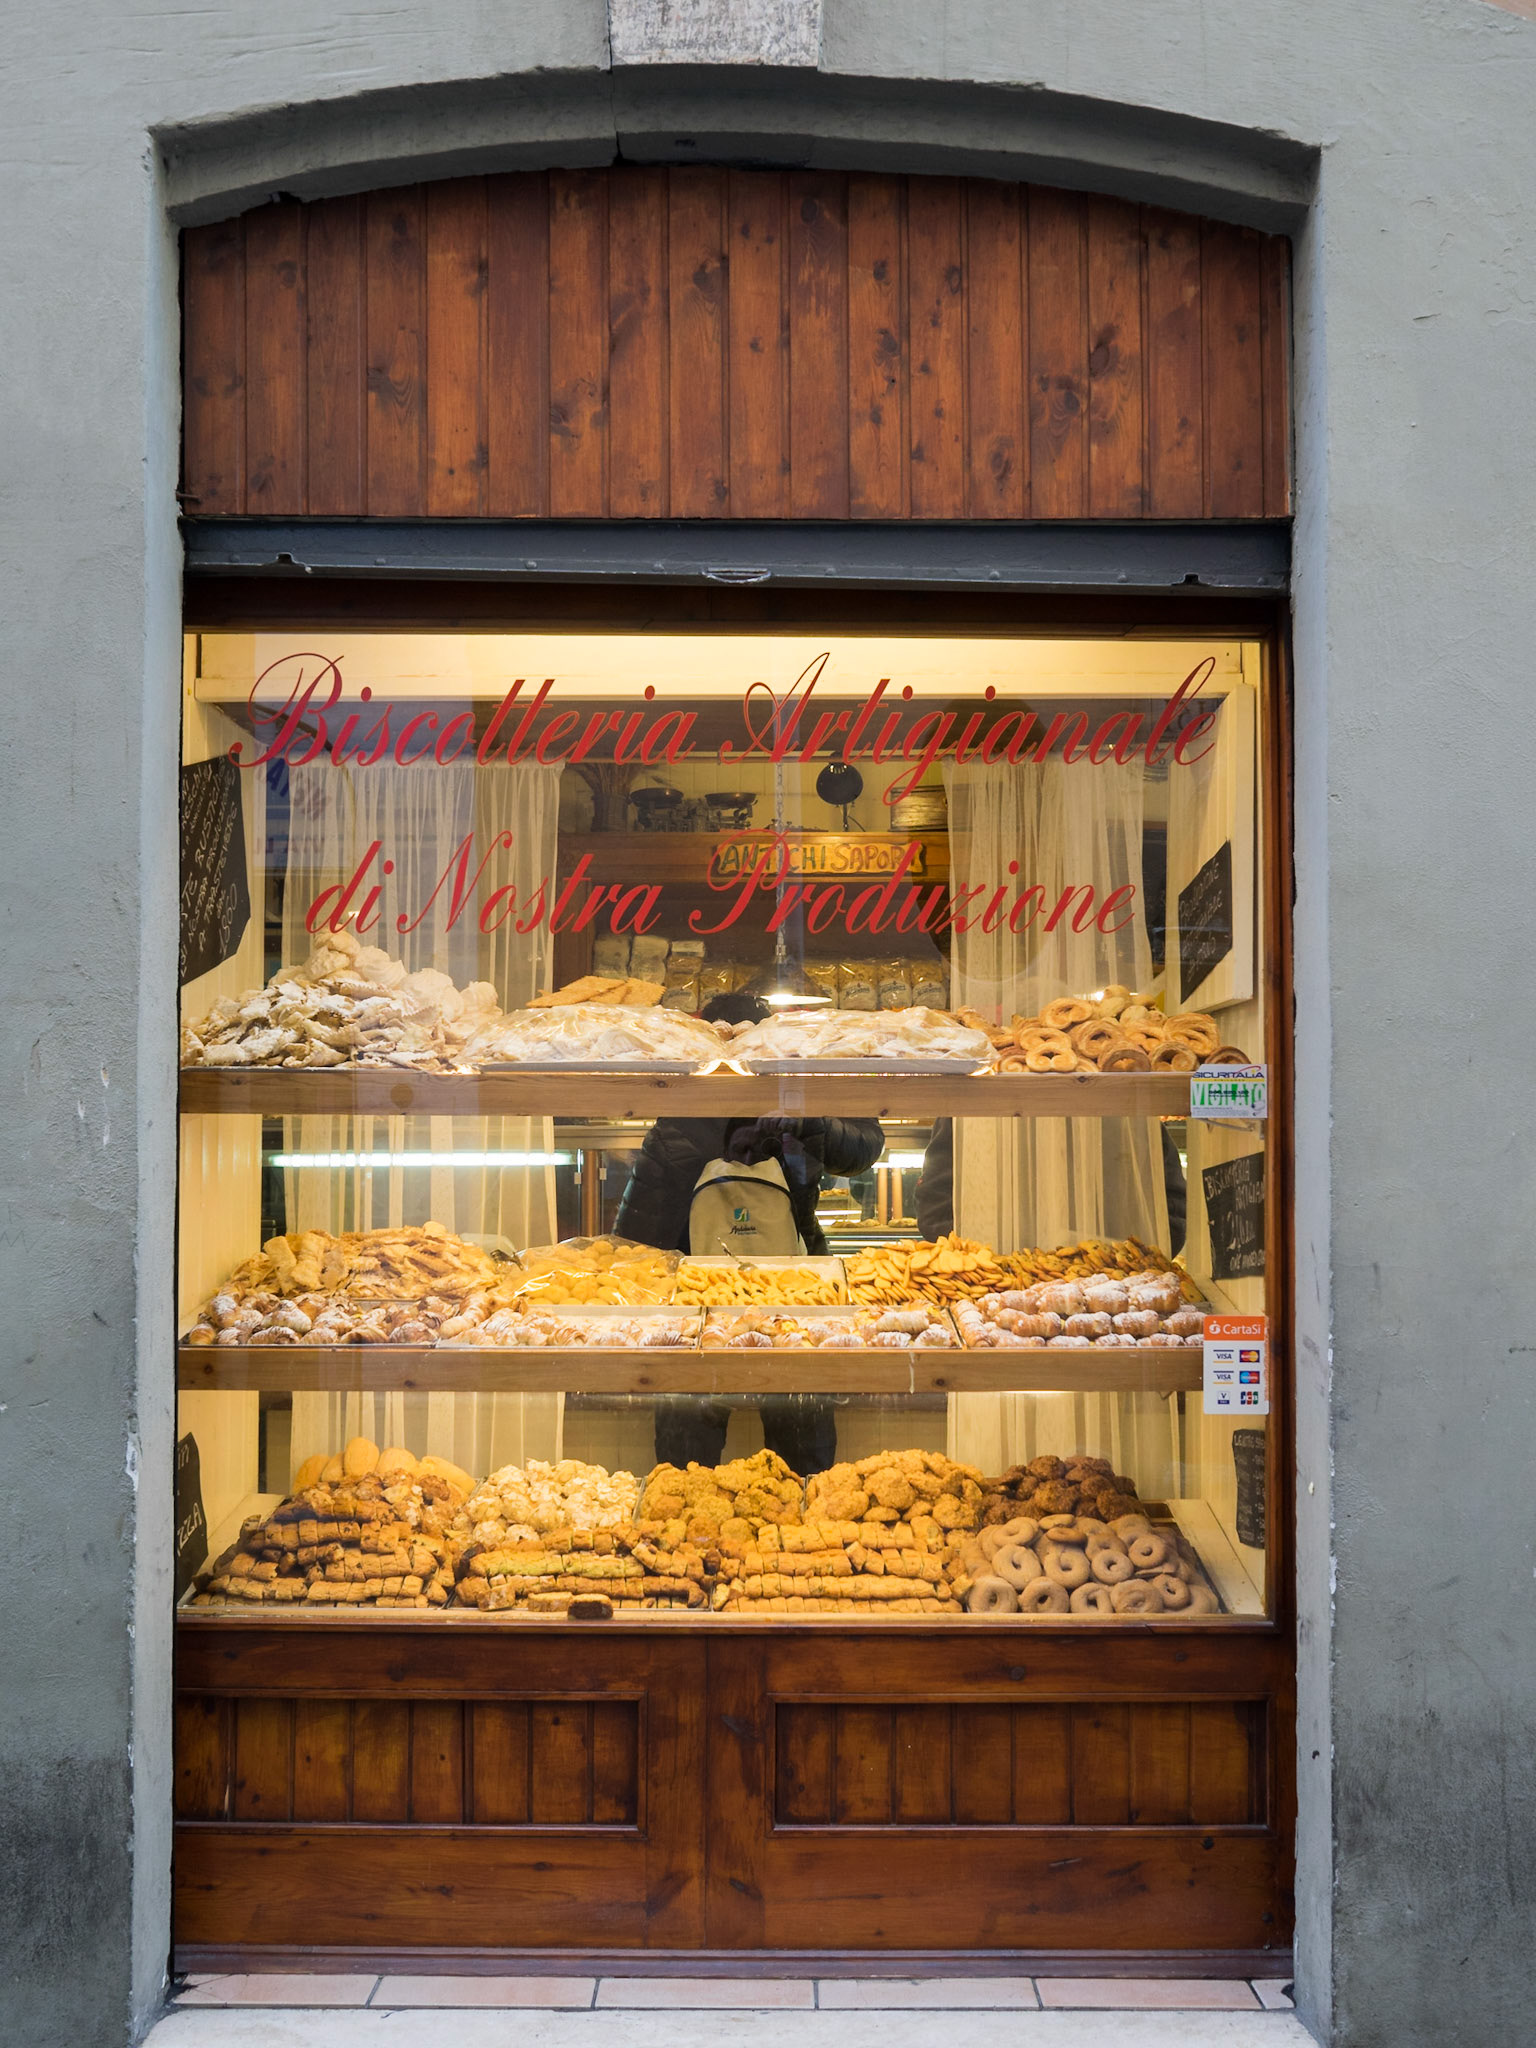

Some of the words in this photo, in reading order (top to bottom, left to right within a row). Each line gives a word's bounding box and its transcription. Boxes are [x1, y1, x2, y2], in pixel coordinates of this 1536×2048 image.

[228, 652, 698, 767] Biscotteria
[721, 652, 1217, 806] Artigianale
[306, 840, 394, 935] di
[397, 830, 665, 935] Nostra
[689, 828, 1136, 935] Produzione
[721, 845, 825, 872] ANTCHI
[1222, 1323, 1261, 1335] CartaSi
